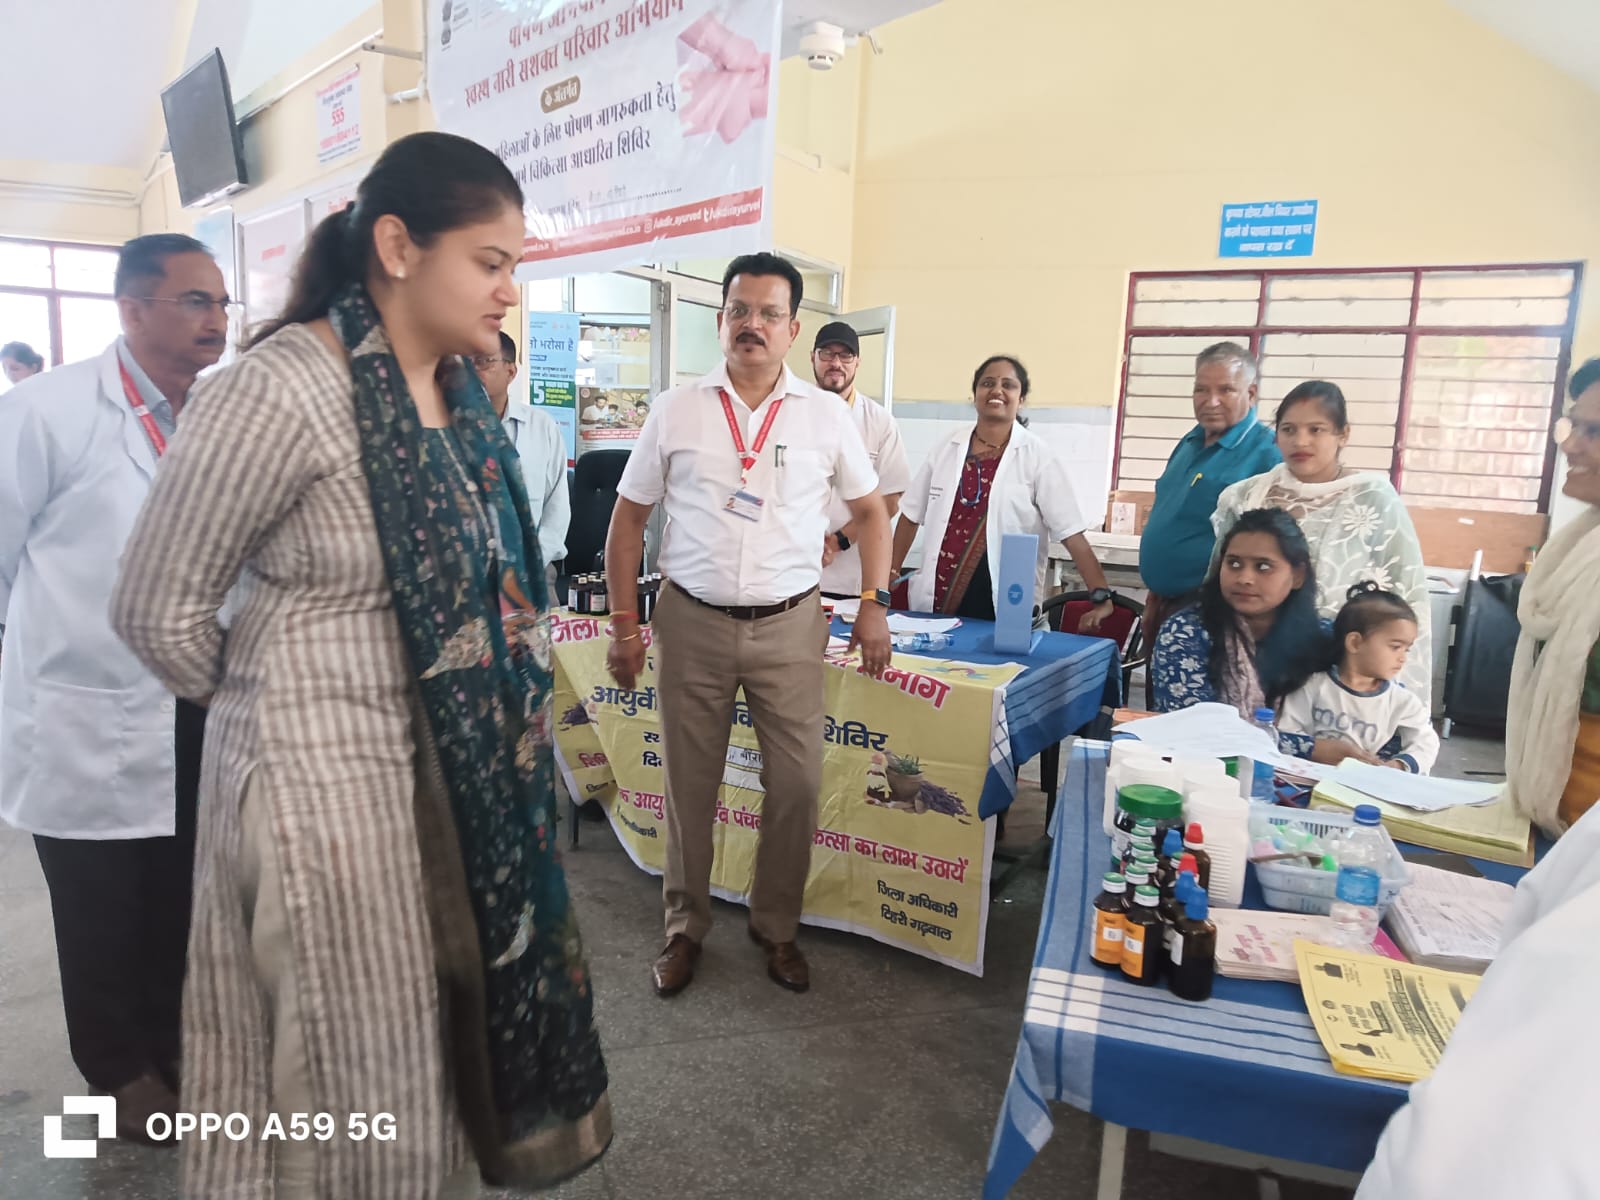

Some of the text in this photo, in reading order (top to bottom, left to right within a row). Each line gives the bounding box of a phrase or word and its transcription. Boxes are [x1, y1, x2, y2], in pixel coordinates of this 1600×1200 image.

[493, 58, 515, 93] नारी
[519, 43, 559, 82] सशक्त
[563, 23, 609, 60] परिवार
[564, 114, 593, 138] पोषण
[656, 81, 676, 113] हेतु
[570, 138, 613, 169] आधारित
[617, 125, 651, 157] शिविर
[540, 337, 565, 351] भरोसा
[568, 336, 574, 352] है
[533, 380, 545, 404] 5
[855, 838, 878, 859] का
[882, 844, 918, 870] लाभ
[922, 857, 969, 883] उठायें
[877, 880, 959, 919] जिला अधिकारी
